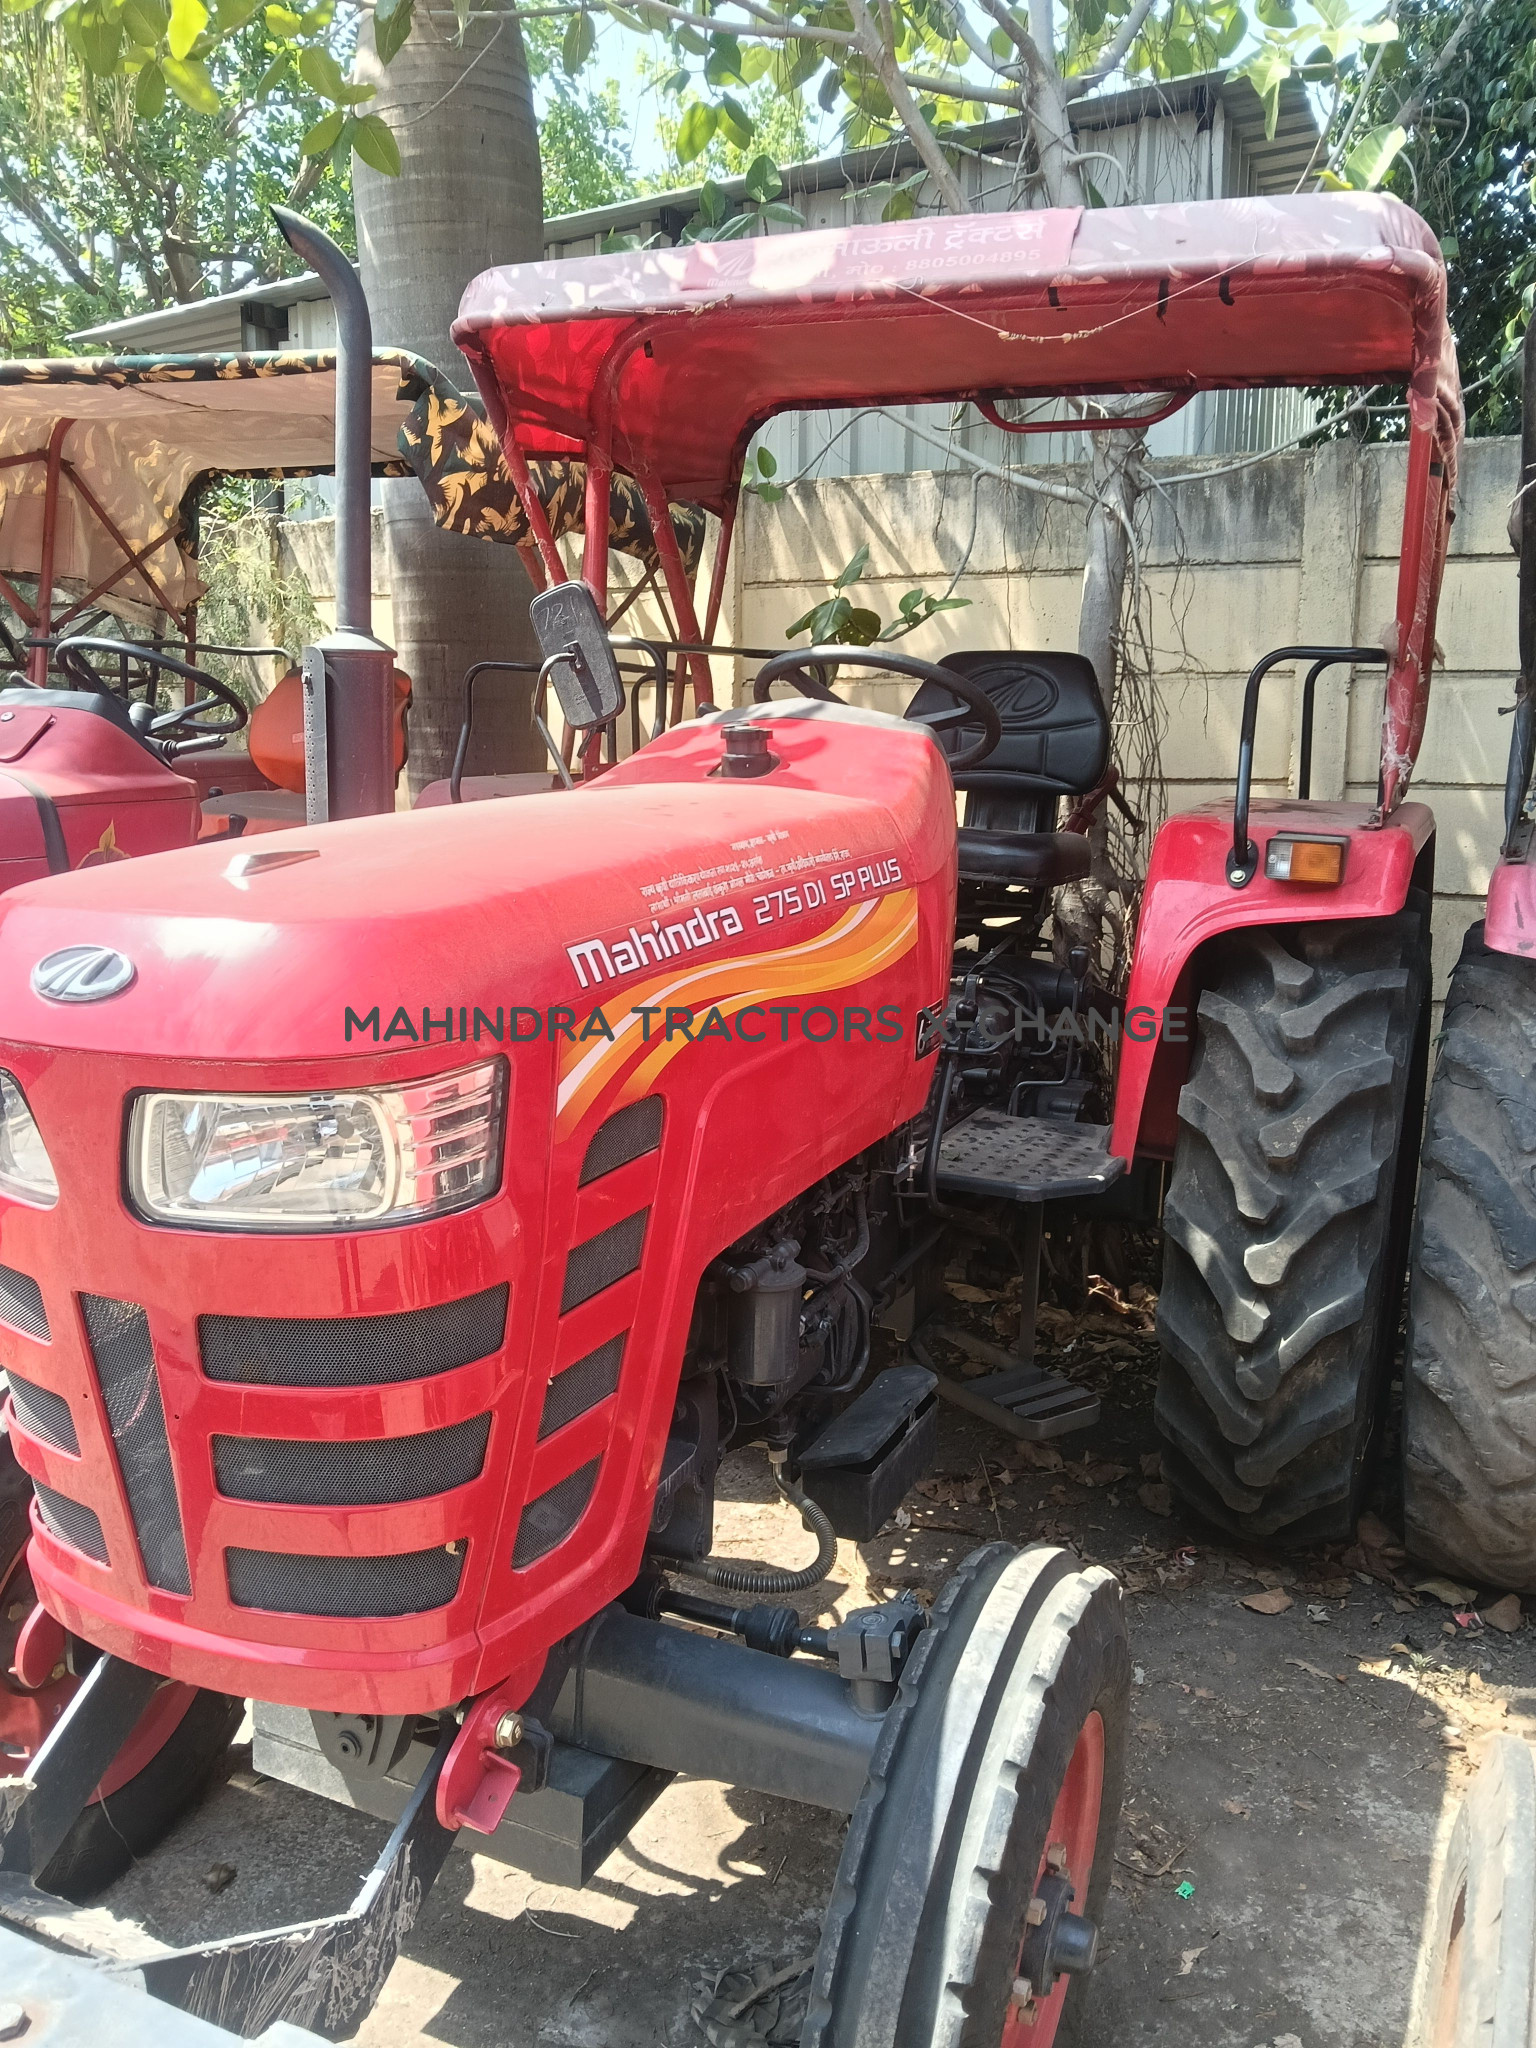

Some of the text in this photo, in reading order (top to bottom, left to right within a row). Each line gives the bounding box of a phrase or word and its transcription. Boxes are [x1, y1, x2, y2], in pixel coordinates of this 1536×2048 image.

[904, 249, 1042, 272] 8805004895
[566, 906, 745, 989] Mahindra
[752, 886, 803, 926] 275
[803, 879, 827, 909] DI
[830, 870, 856, 900] SP
[857, 858, 902, 891] PLUS
